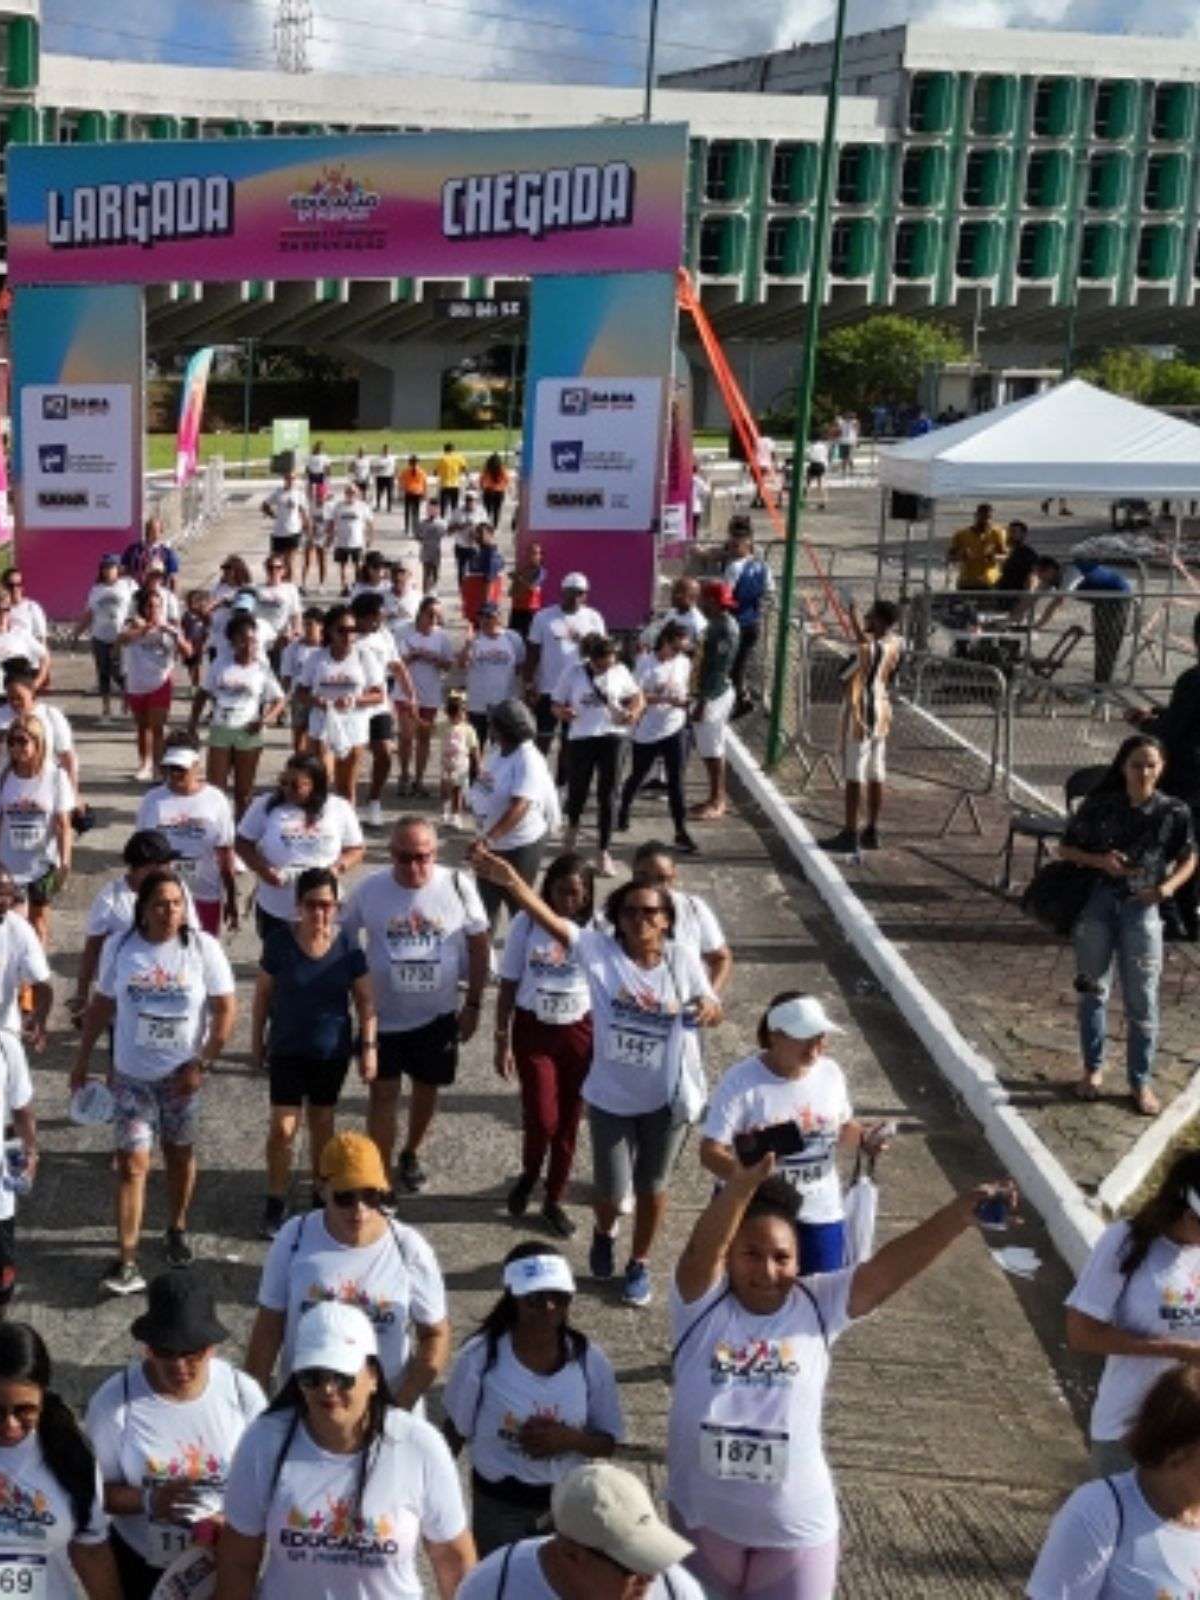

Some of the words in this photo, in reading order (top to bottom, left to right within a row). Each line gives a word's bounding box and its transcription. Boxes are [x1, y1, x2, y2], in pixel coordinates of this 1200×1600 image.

[46, 174, 233, 247] LARGADA
[441, 160, 635, 240] CHEGADA
[713, 1439, 773, 1466] 1871
